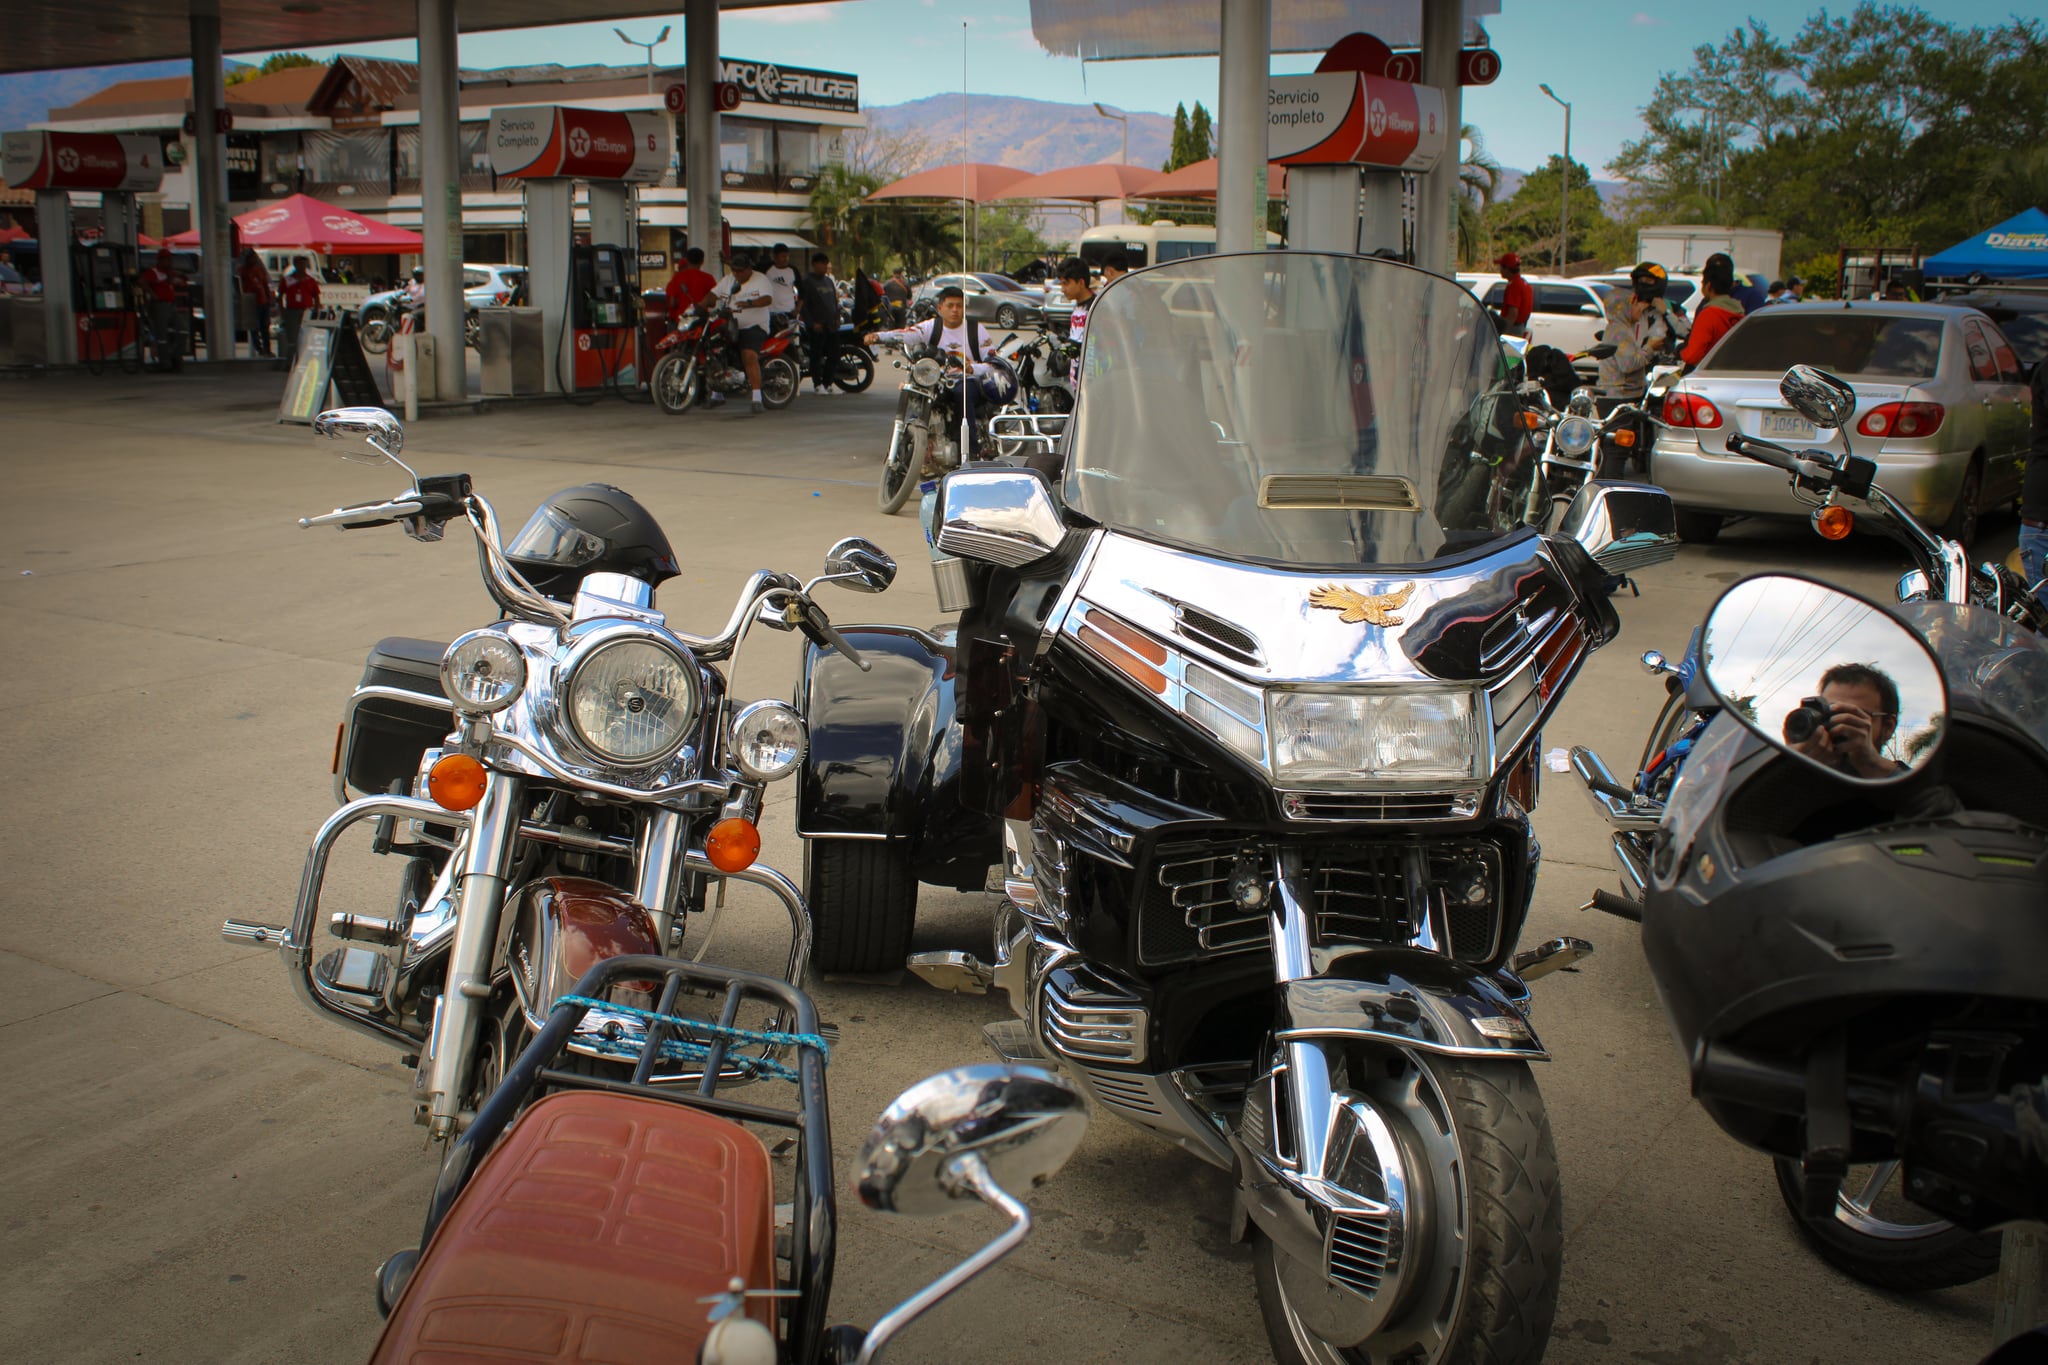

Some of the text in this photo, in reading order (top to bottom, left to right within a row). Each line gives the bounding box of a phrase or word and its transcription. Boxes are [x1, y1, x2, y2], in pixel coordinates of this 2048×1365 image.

[1395, 62, 1404, 79] 7
[1479, 57, 1489, 77] 8
[780, 73, 857, 101] SANUCASA
[671, 90, 678, 107] 5
[727, 88, 735, 104] 6
[1268, 89, 1319, 105] Servicio
[500, 119, 535, 131] Servicio
[1268, 109, 1325, 127] ompleto
[497, 134, 539, 149] Completo
[647, 133, 657, 152] 6
[639, 254, 664, 263] UCASA
[321, 291, 359, 300] TOYOTA
